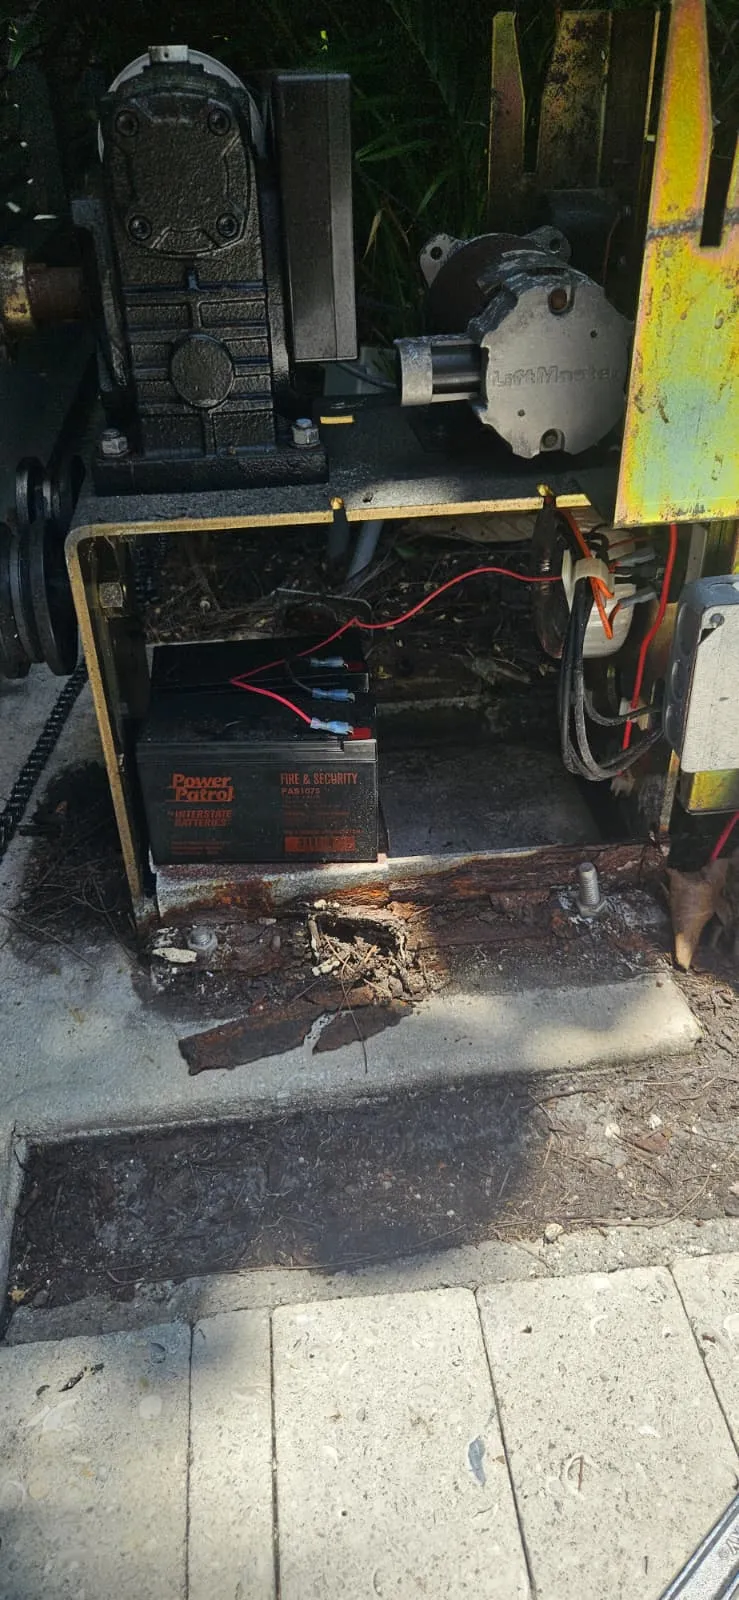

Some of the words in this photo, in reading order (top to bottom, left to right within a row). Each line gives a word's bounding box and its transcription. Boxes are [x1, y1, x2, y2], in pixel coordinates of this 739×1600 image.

[491, 365, 621, 387] LiftMaster
[172, 773, 233, 789] Power
[280, 772, 300, 785] FIRE
[303, 773, 311, 785] &
[313, 772, 359, 785] SECURITY
[175, 786, 234, 802] Patrol
[175, 809, 233, 819] INTERSTATE
[174, 819, 228, 828] BATTERIES
